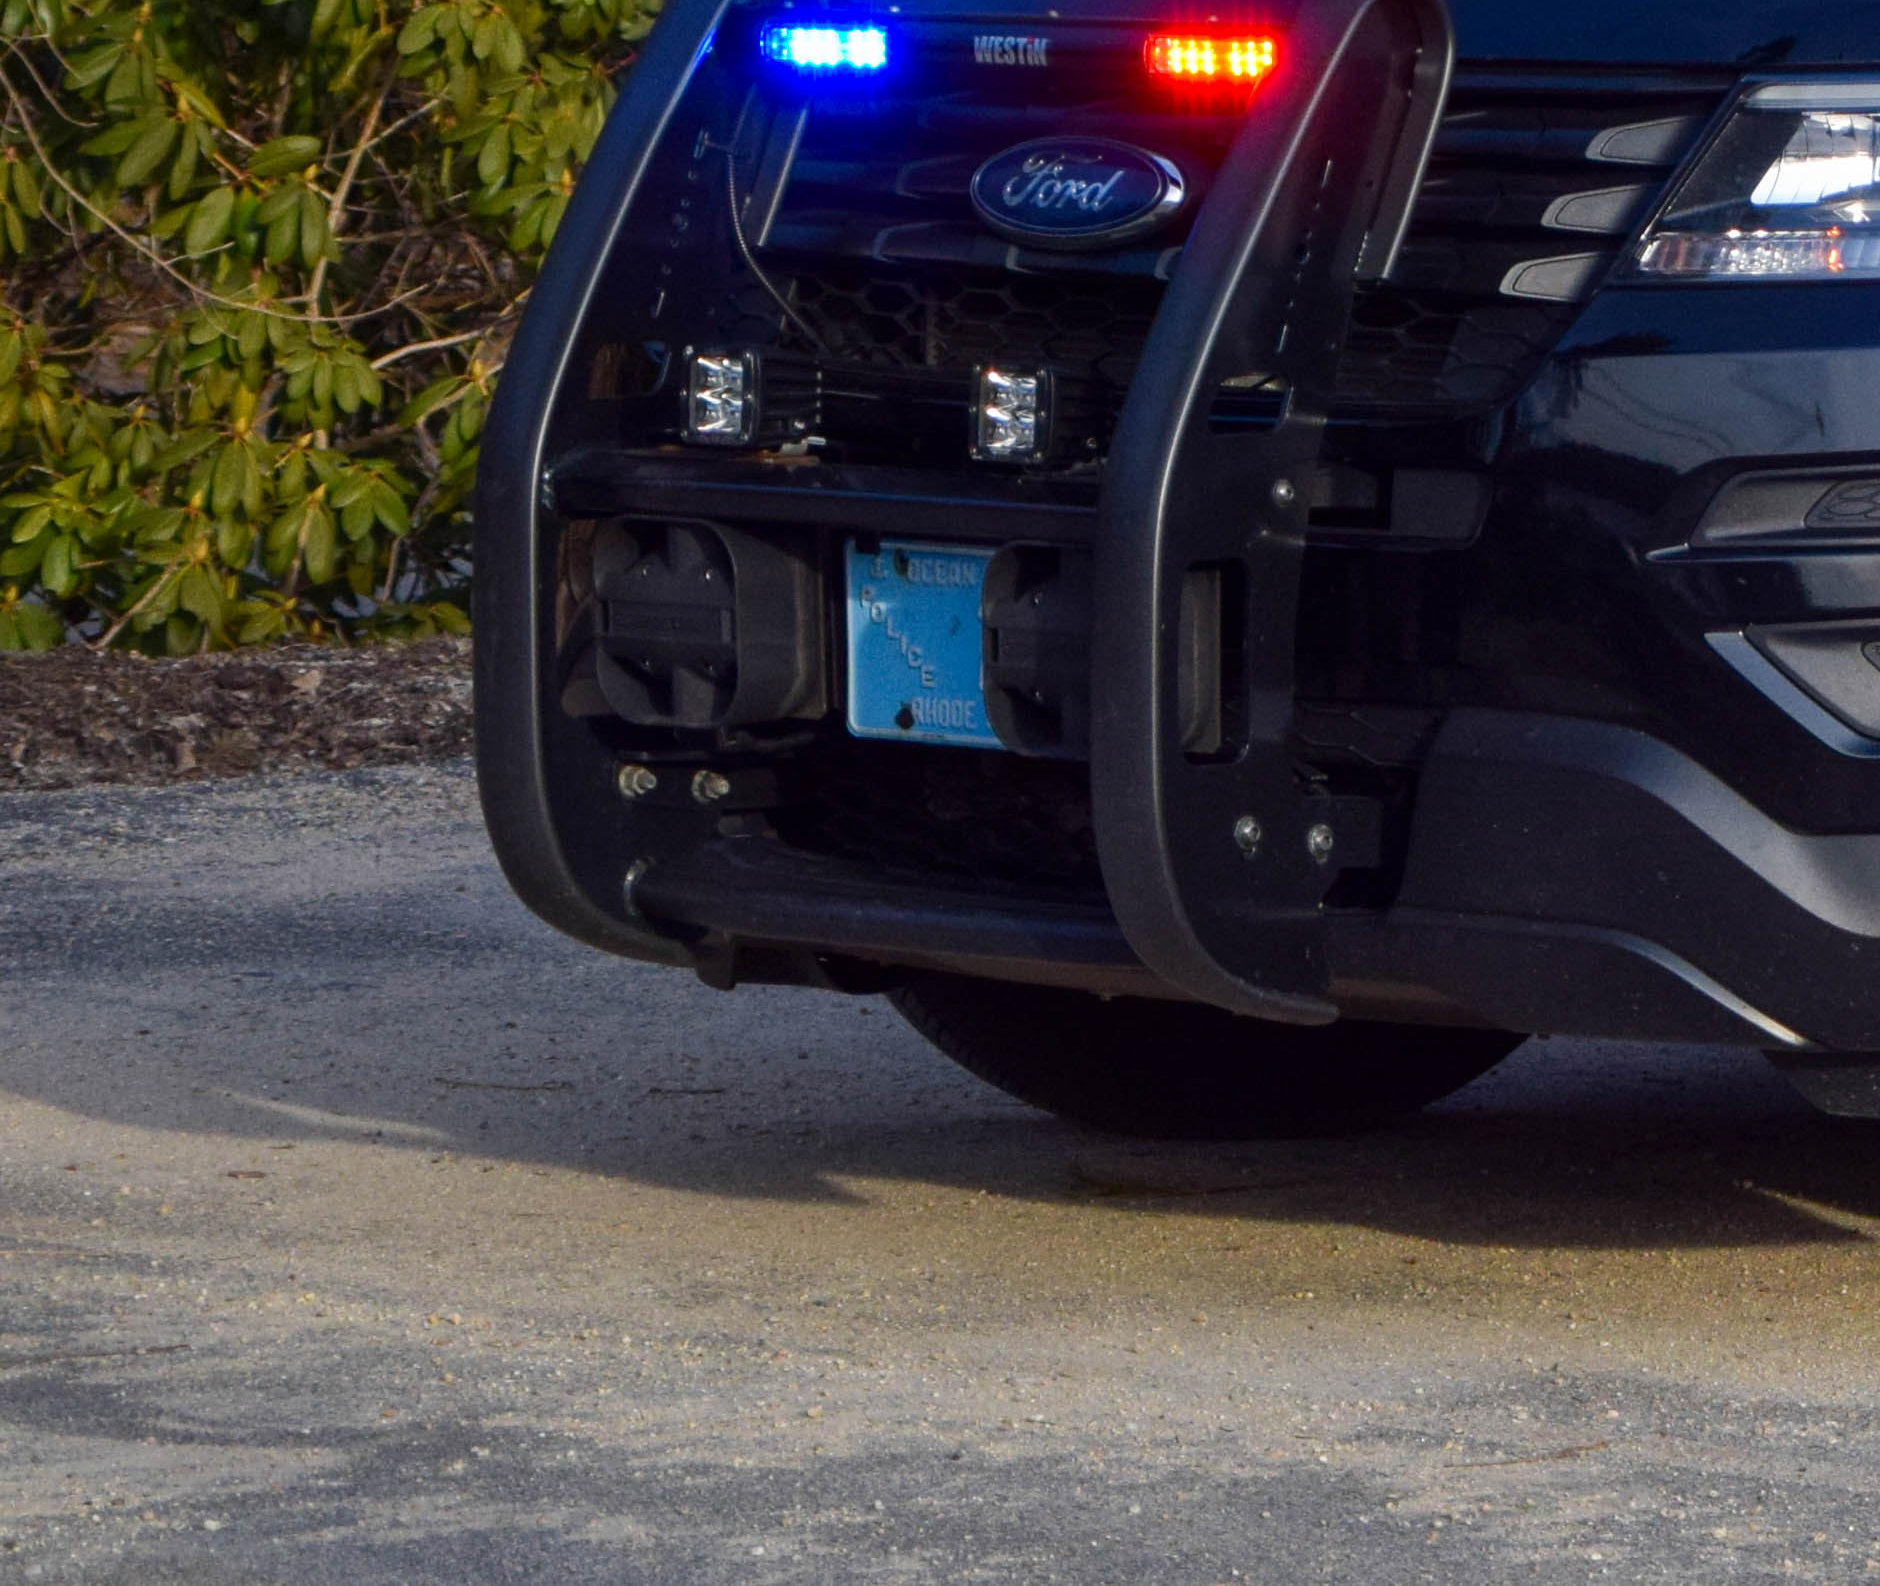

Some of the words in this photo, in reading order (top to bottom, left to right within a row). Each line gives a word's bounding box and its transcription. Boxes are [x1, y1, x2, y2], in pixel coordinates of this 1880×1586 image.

[1002, 151, 1126, 211] Ford
[907, 557, 977, 587] OCEAN
[860, 585, 936, 688] POLICE
[911, 696, 977, 729] RHODE
